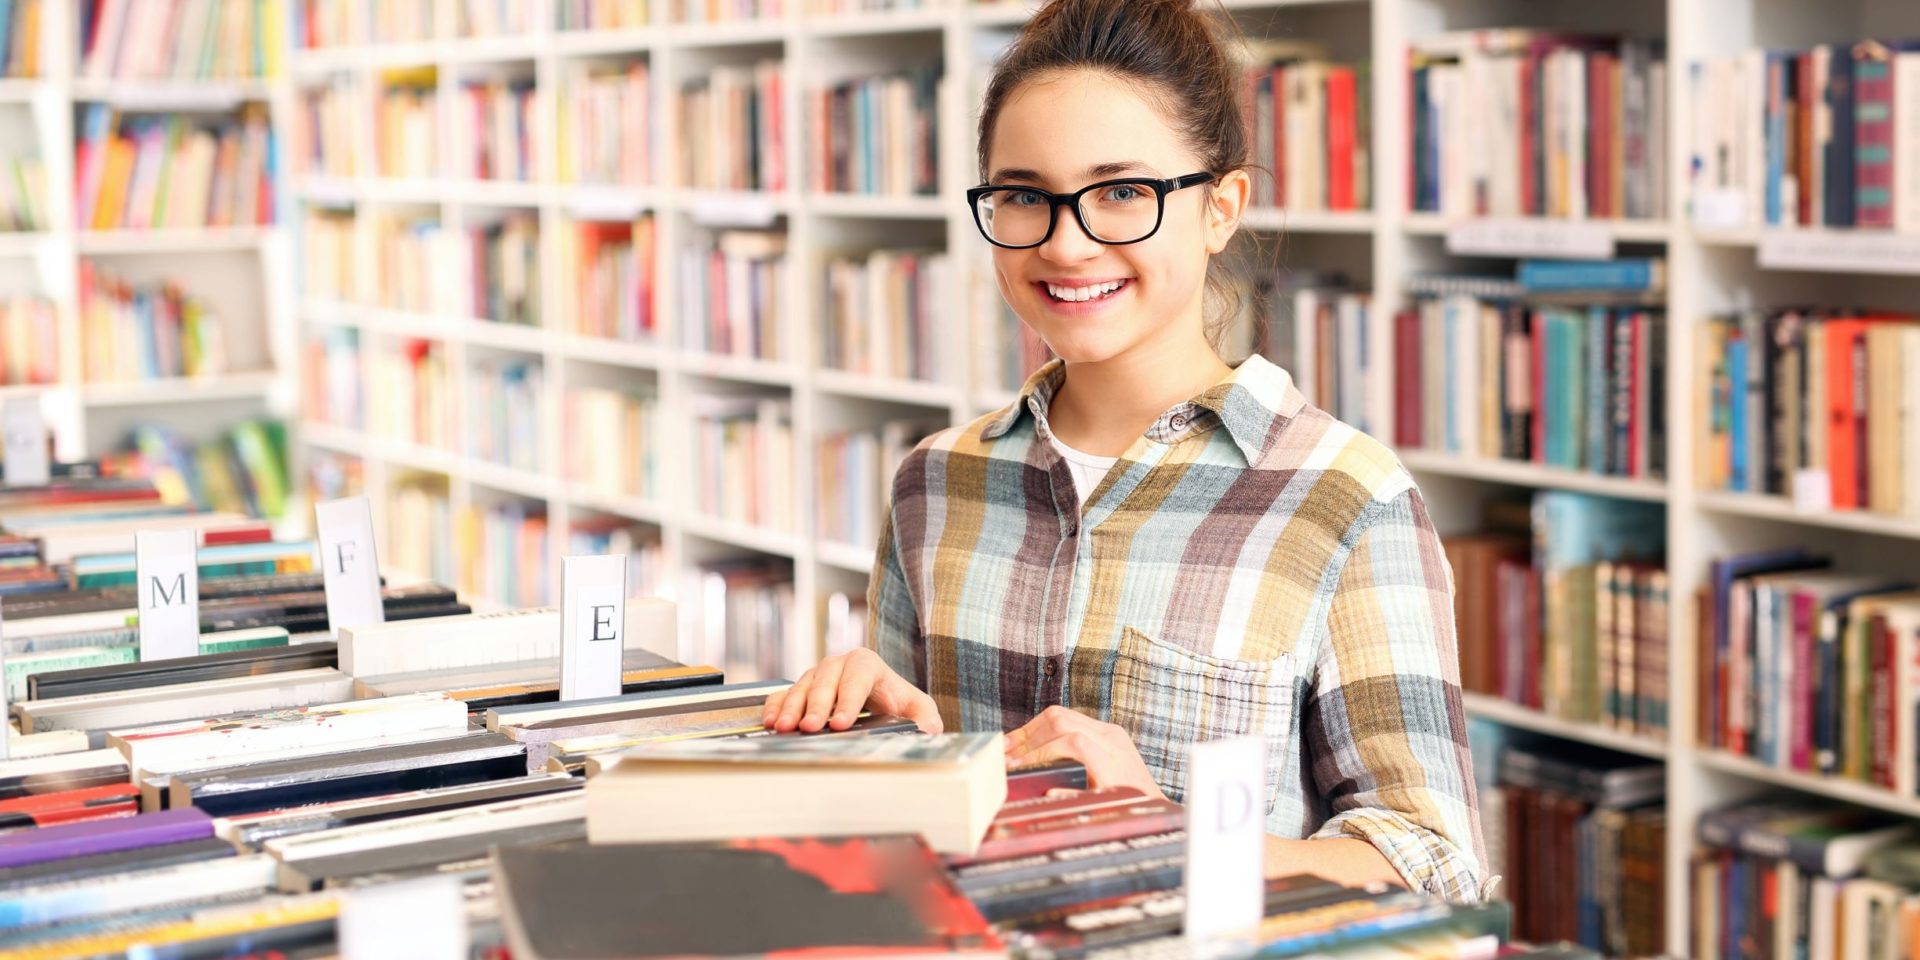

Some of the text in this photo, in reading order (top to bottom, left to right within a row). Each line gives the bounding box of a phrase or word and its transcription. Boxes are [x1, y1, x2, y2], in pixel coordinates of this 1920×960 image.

[335, 540, 356, 575] F
[149, 572, 189, 609] M
[589, 604, 616, 642] E
[1214, 779, 1254, 834] D
